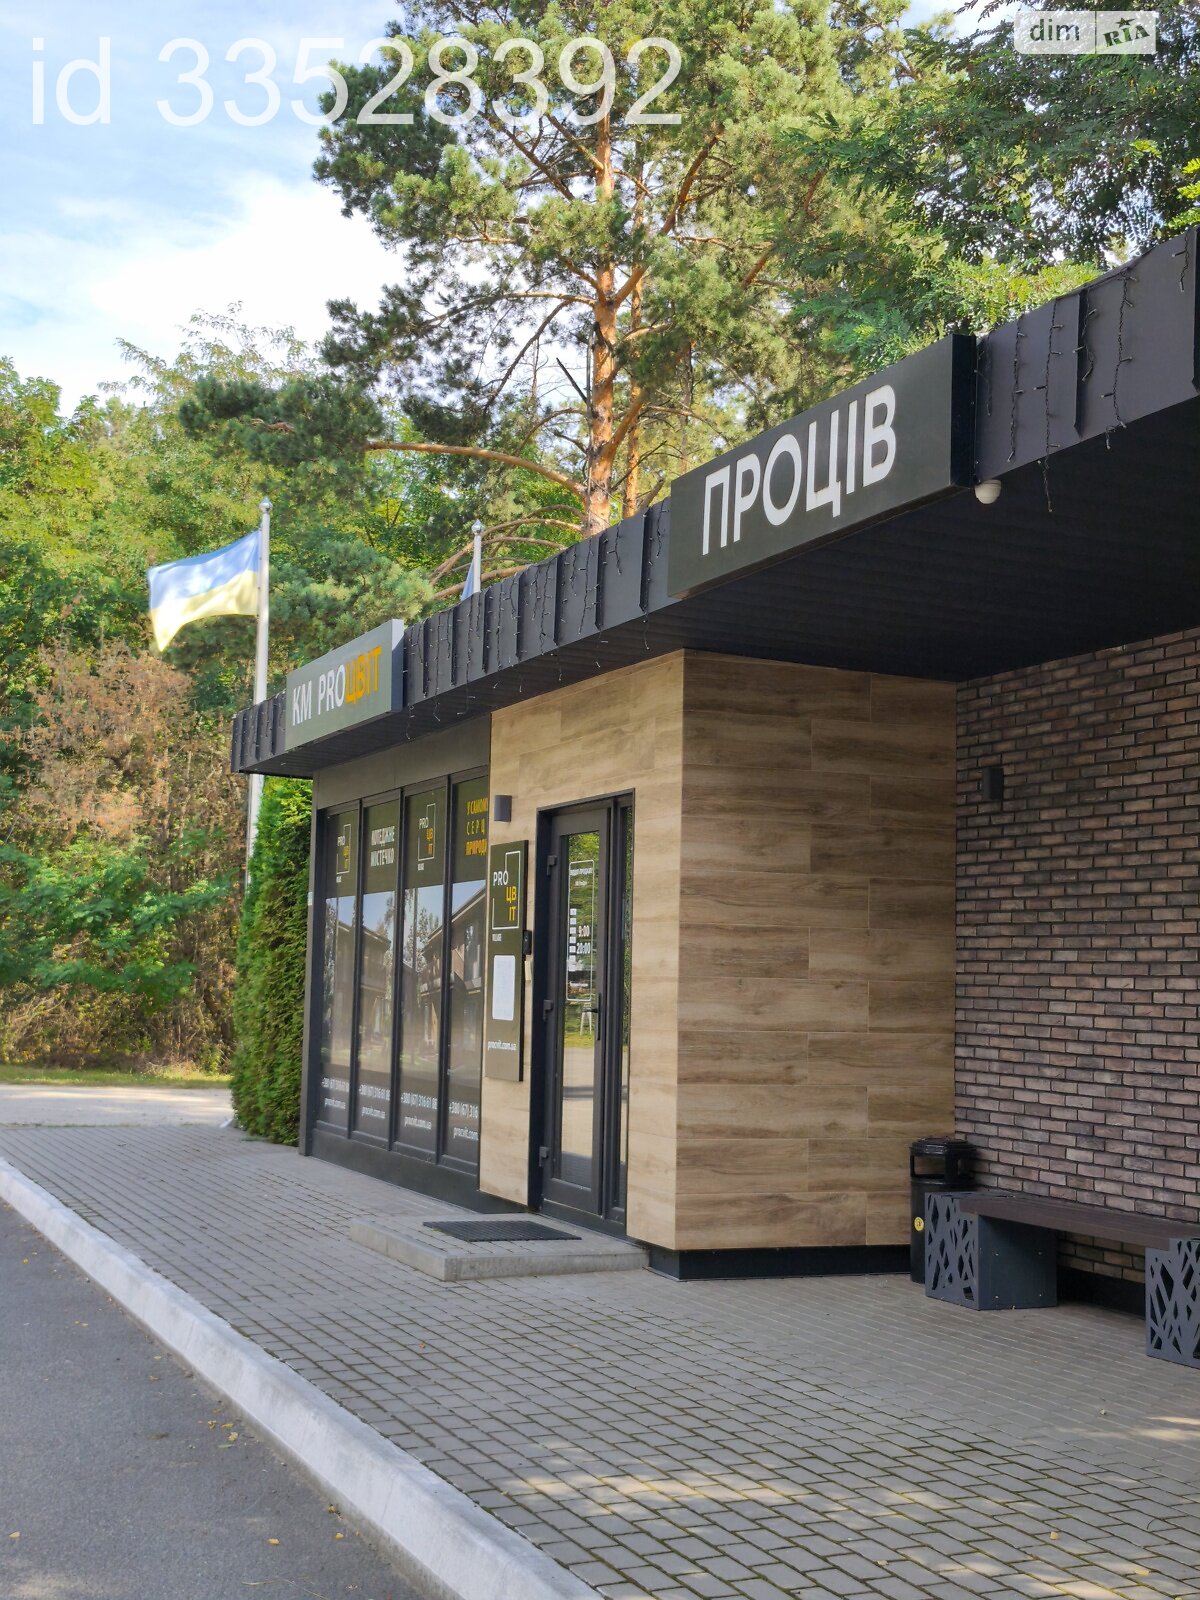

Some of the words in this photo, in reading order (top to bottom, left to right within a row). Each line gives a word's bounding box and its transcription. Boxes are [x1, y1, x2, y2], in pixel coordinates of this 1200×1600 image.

[702, 384, 897, 556] ПРОЦІВ
[493, 870, 509, 886] PRO
[506, 886, 517, 903] ЦВ
